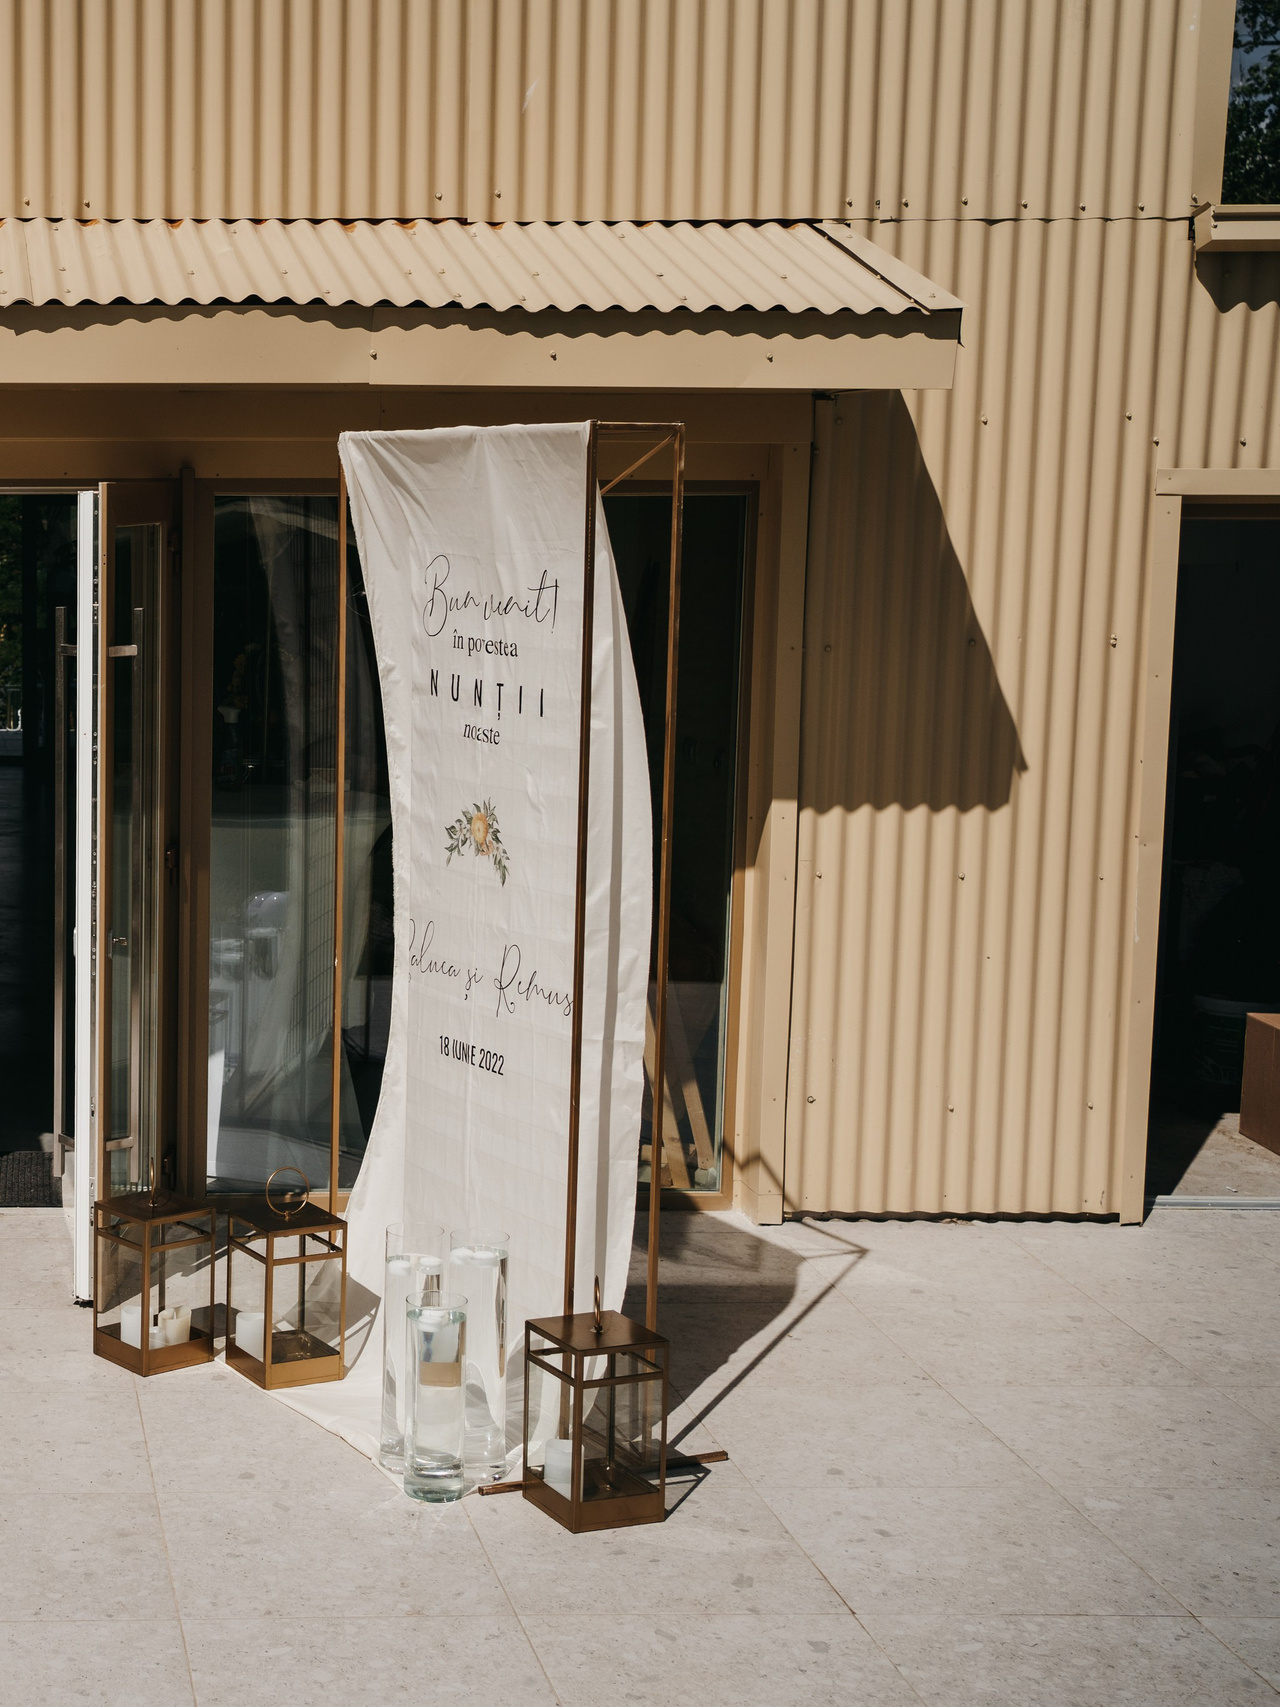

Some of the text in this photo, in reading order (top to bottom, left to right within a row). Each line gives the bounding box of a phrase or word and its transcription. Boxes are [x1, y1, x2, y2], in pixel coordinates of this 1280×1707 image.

[422, 554, 560, 637] Bun venit!
[452, 628, 464, 650] în
[439, 1034, 505, 1076] 18 IUNIE 2022
